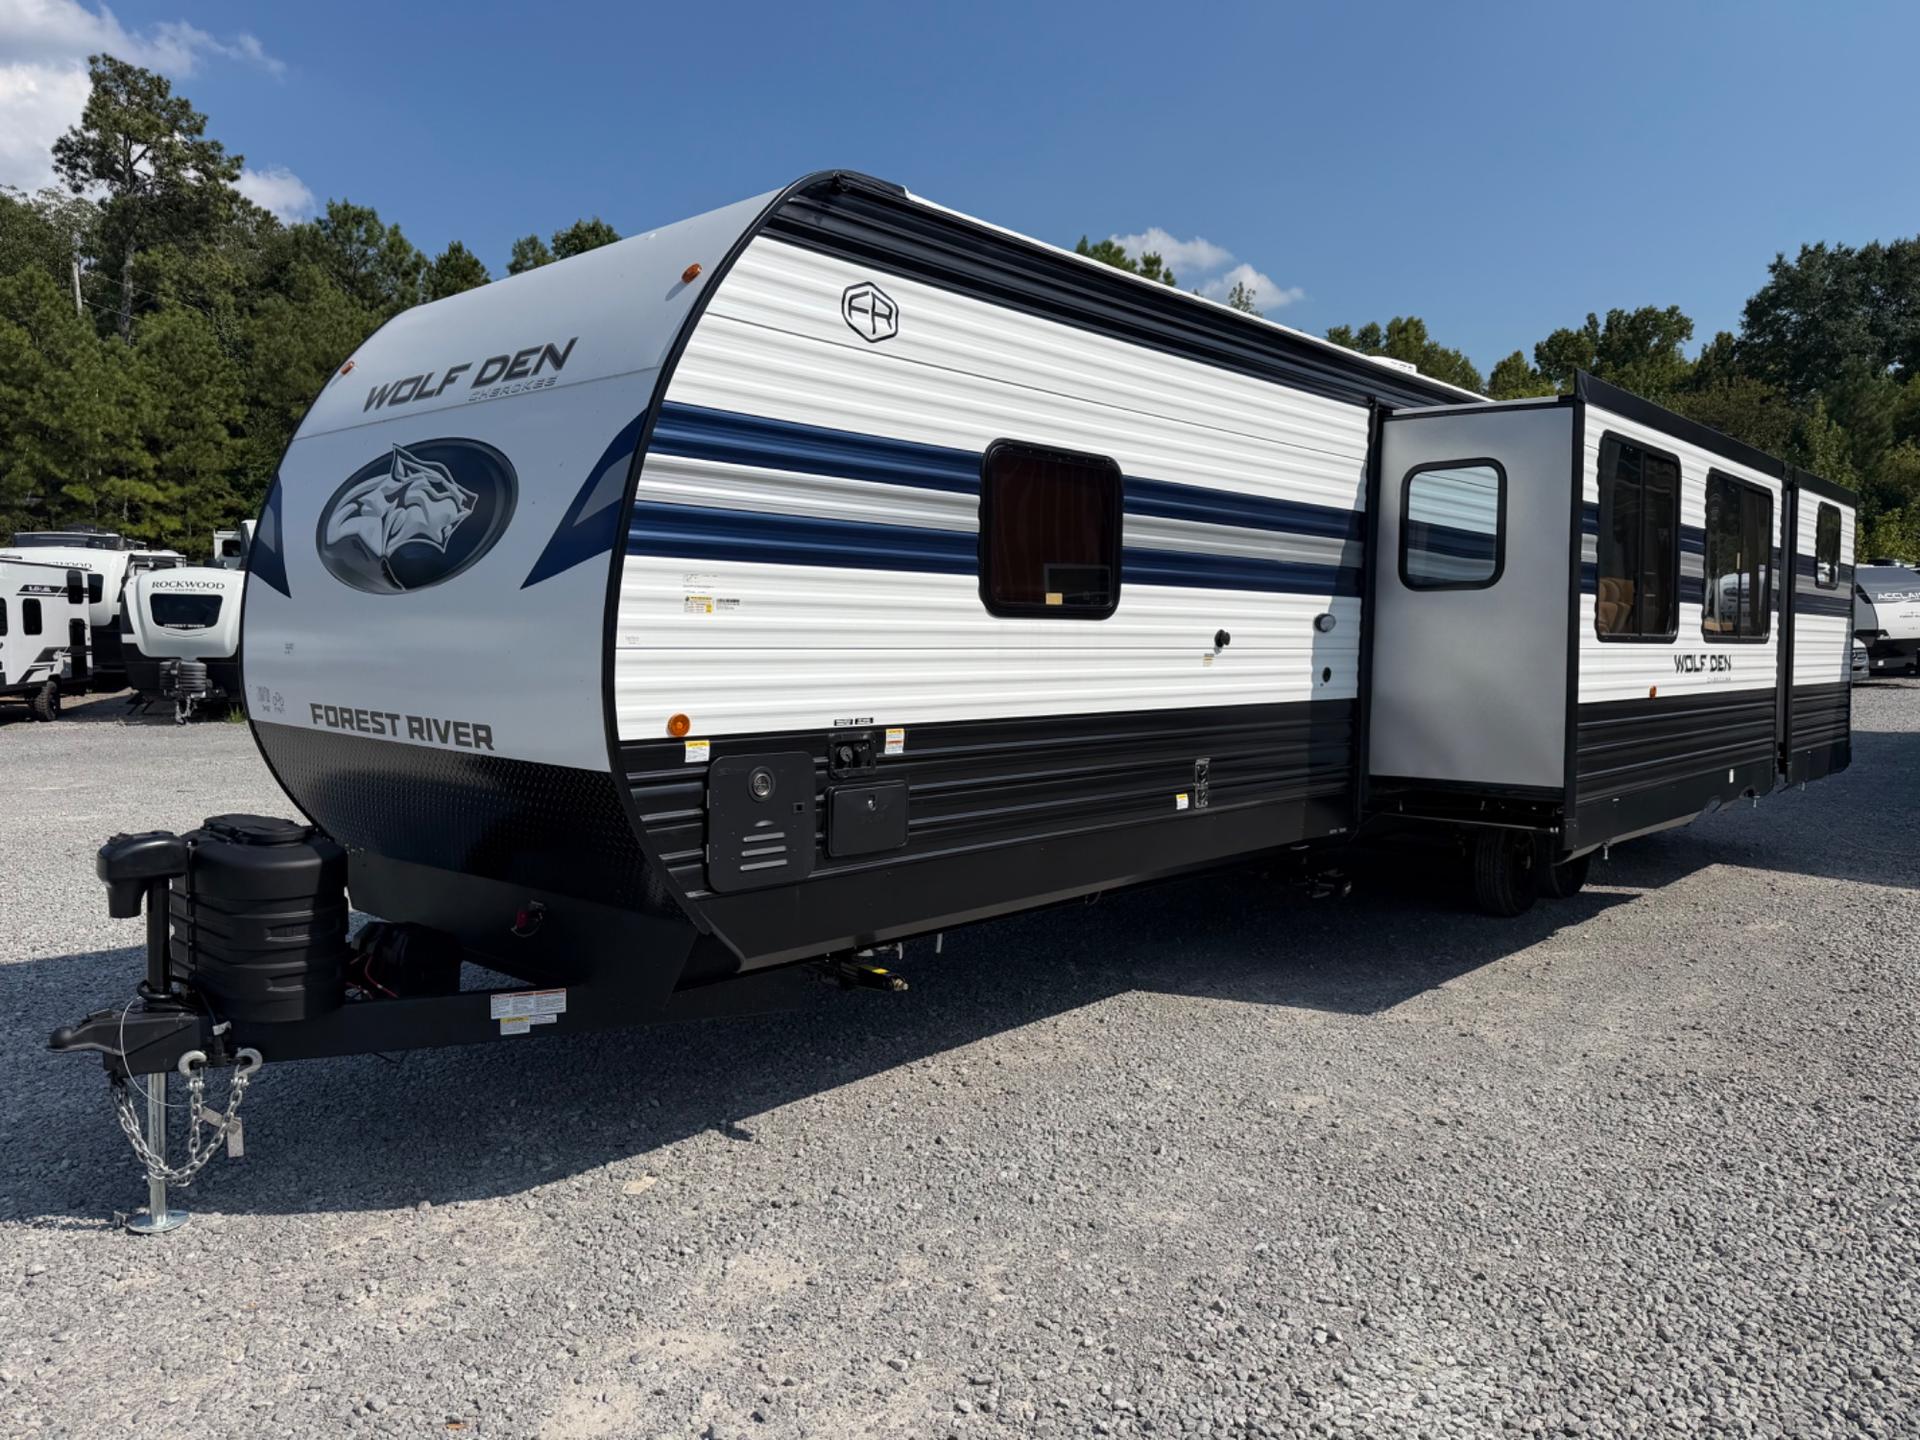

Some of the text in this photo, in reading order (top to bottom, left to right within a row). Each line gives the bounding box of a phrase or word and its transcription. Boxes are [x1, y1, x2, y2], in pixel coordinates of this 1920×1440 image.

[363, 336, 579, 413] WOLF DEN
[152, 581, 225, 589] ROCKWOOD
[1673, 654, 1732, 674] WOLF DEN
[309, 702, 495, 751] FOREST RIVER
